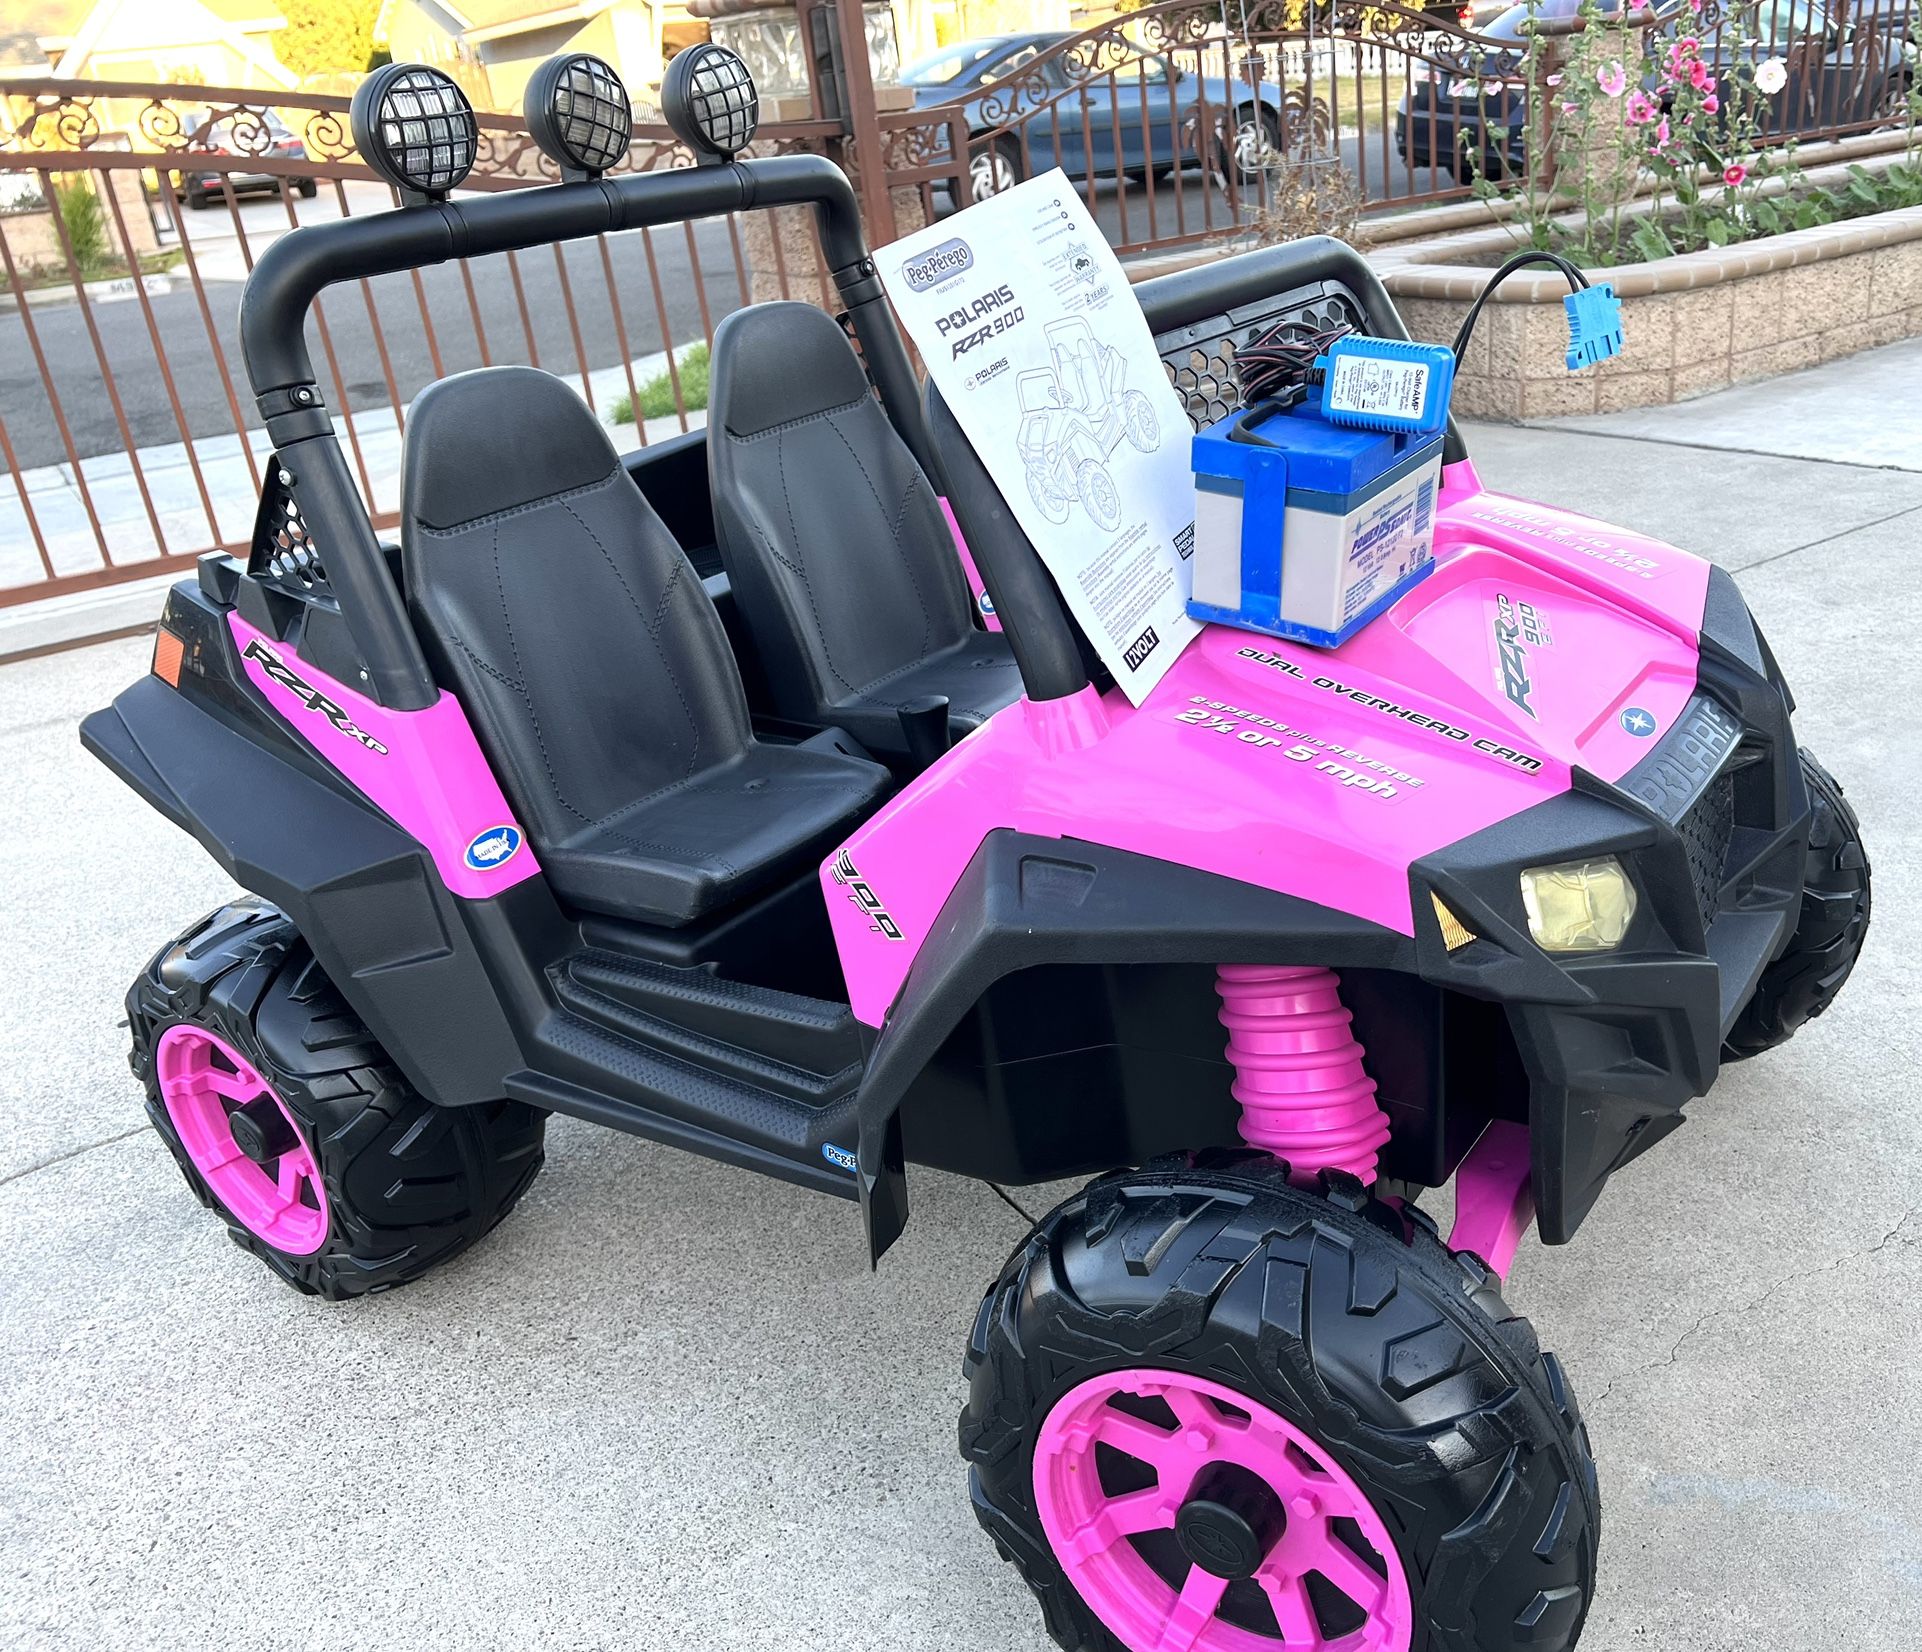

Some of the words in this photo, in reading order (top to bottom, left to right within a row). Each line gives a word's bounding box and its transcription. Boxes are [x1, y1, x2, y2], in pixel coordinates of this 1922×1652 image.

[1063, 243, 1087, 260] EXTENDED
[1076, 265, 1100, 283] WARRANTY
[1091, 286, 1108, 300] YEARS
[935, 284, 1015, 337] POLARIS
[952, 324, 995, 362] RZR
[993, 306, 1025, 335] 900
[975, 357, 1009, 382] POLARIS
[1174, 526, 1192, 546] SMART
[1497, 593, 1515, 626] XP
[1518, 602, 1540, 645] 900
[1125, 629, 1157, 667] 12VOLT
[1494, 618, 1537, 720] RZR
[242, 640, 349, 733] RZR
[343, 722, 388, 755] XP
[1237, 647, 1305, 680] DUAL
[1312, 676, 1470, 741] OVERHEAD
[1472, 738, 1543, 771] CAM
[1236, 731, 1281, 748] or
[1283, 744, 1320, 762] 5
[1315, 760, 1398, 800] mph
[1286, 730, 1326, 748] plus
[1327, 744, 1426, 788] REVERSE
